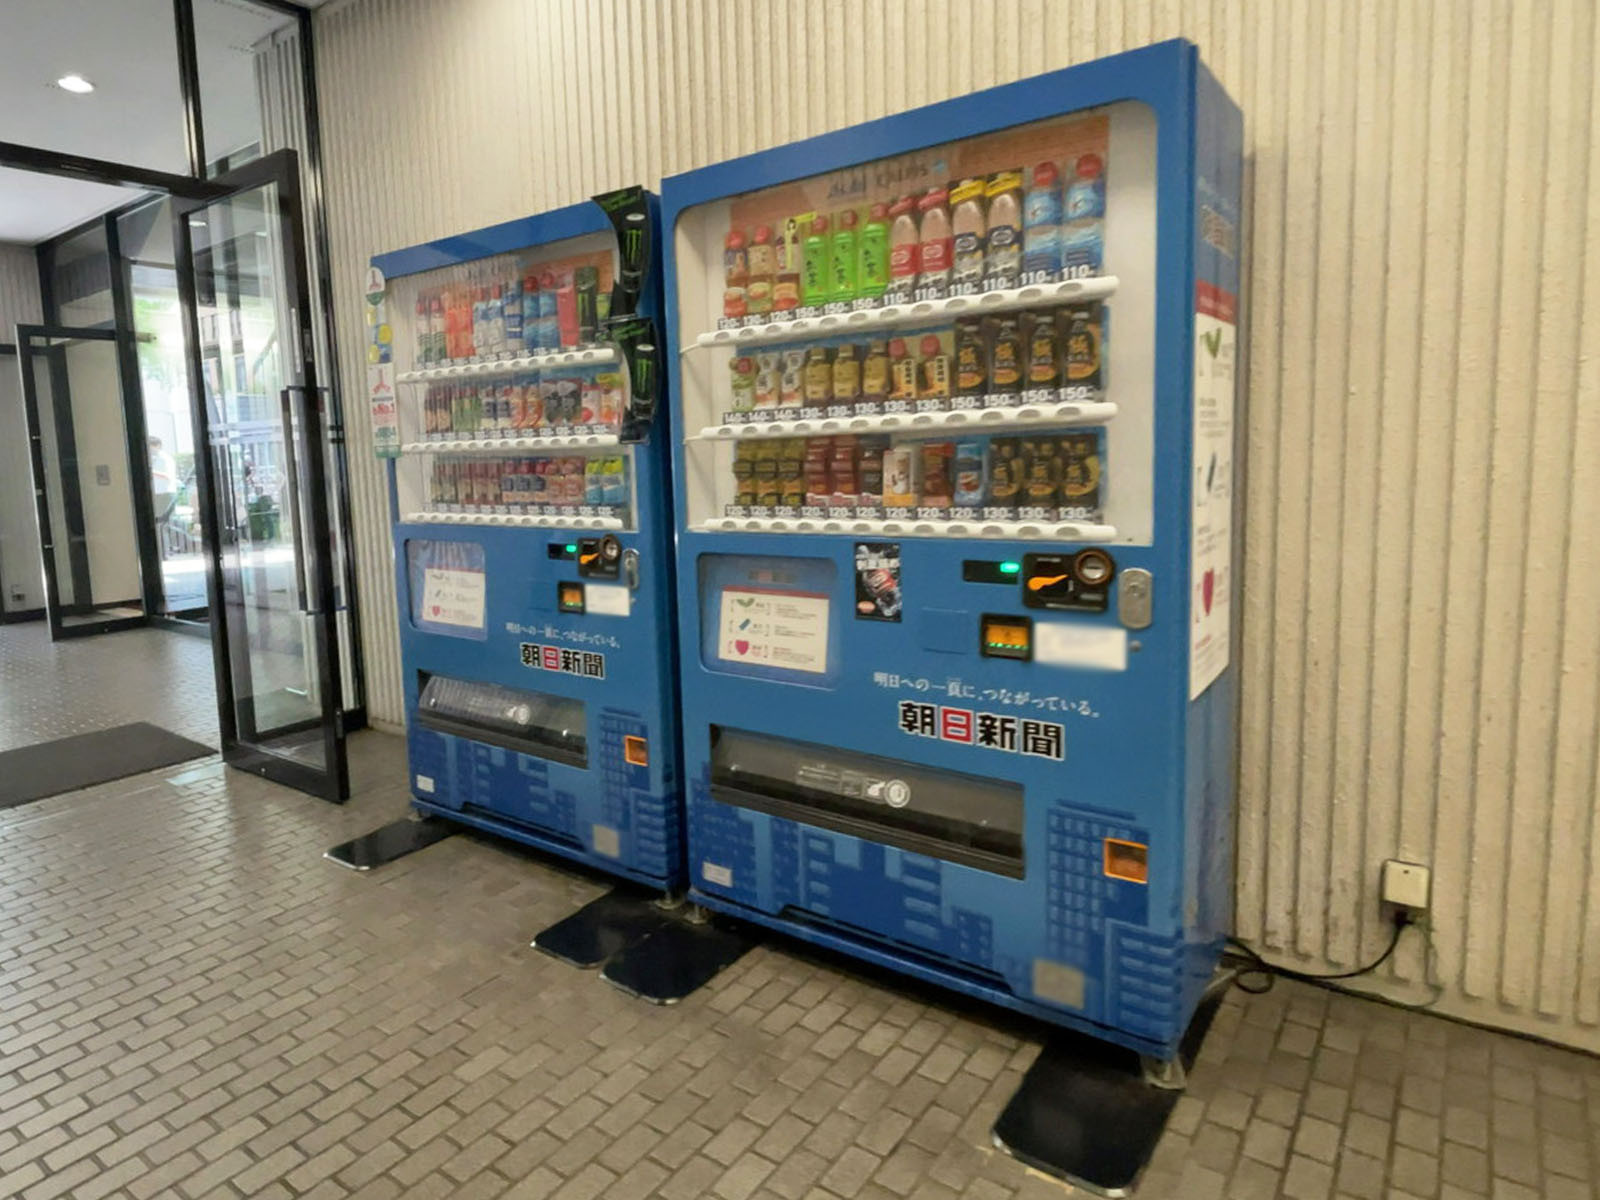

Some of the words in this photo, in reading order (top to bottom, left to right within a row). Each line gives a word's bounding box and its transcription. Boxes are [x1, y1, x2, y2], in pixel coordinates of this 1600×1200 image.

[884, 293, 904, 306] 110
[915, 288, 937, 301] 110
[950, 282, 972, 296] 110
[982, 277, 1006, 291] 110
[1021, 270, 1046, 285] 110
[1062, 264, 1088, 280] 110
[951, 397, 975, 410] 150
[984, 394, 1009, 407] 150
[1021, 390, 1048, 403] 150
[1060, 386, 1087, 400] 150
[520, 642, 605, 680] 朝日新聞
[899, 701, 1065, 761] 朝日新聞
